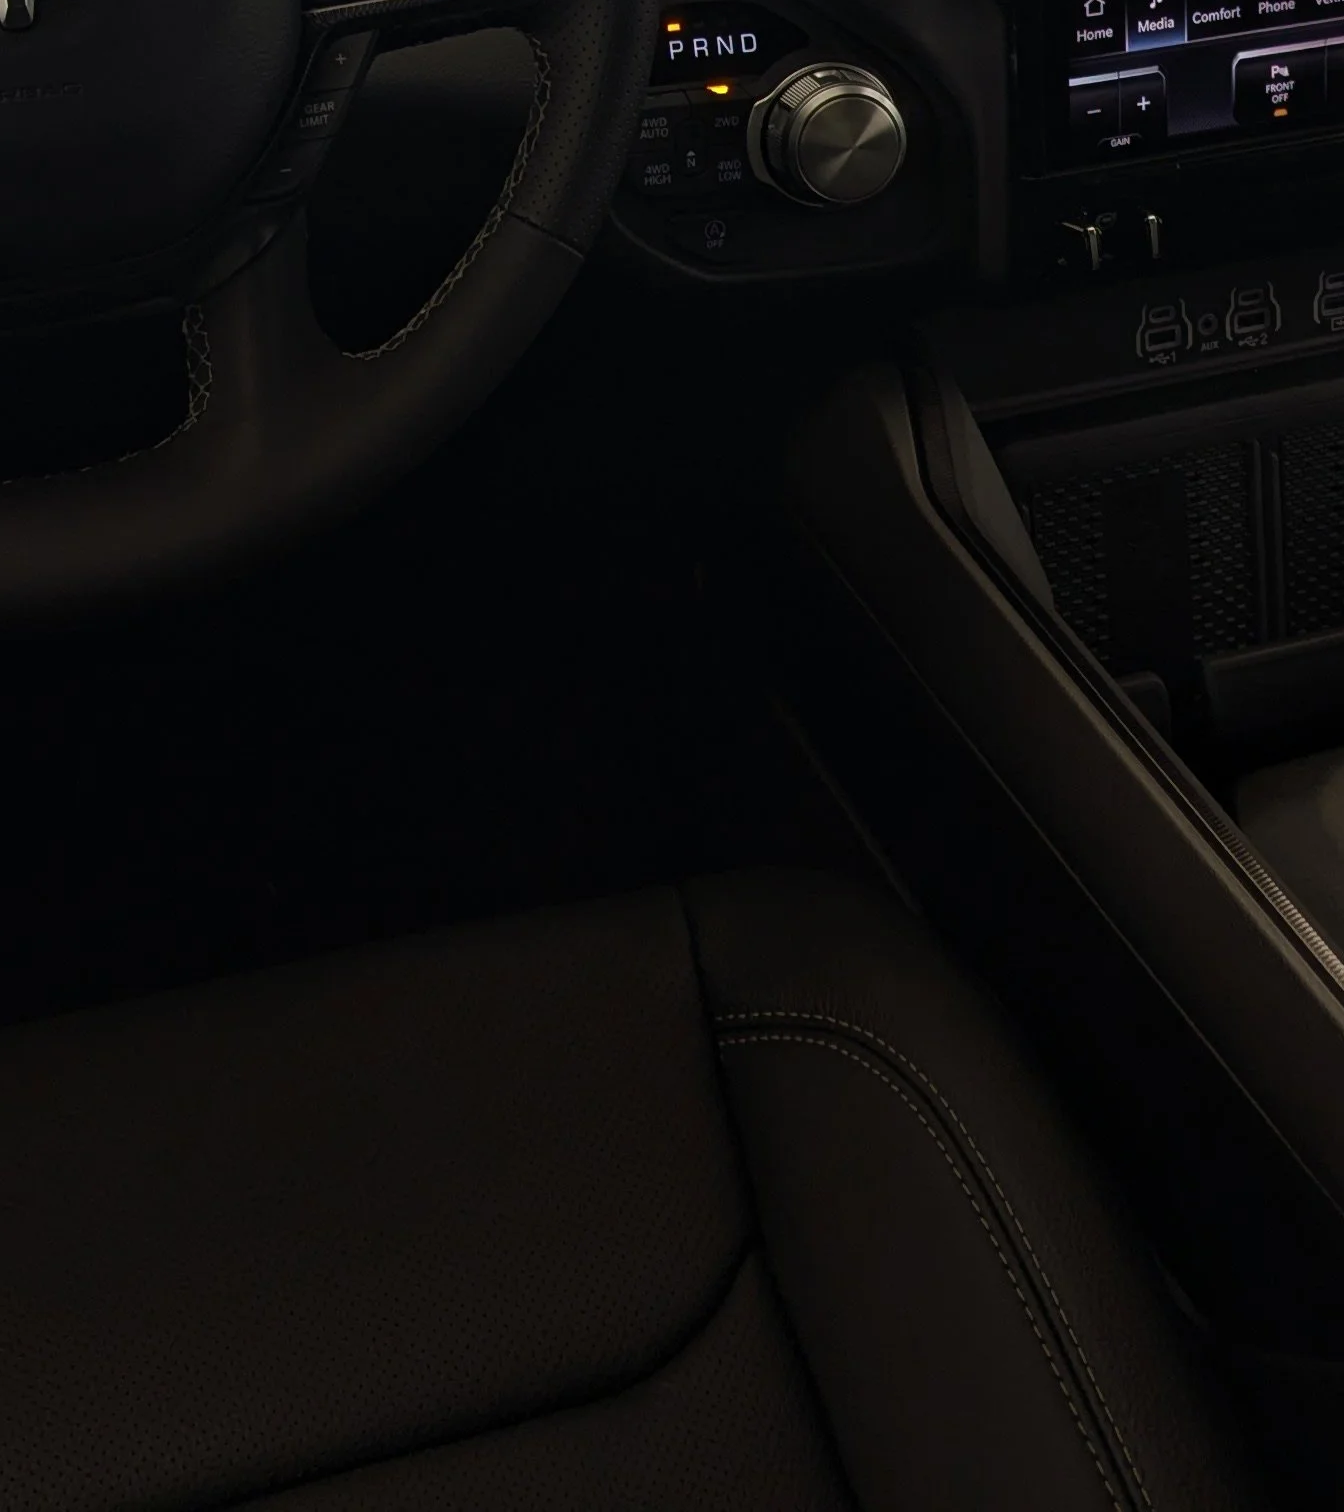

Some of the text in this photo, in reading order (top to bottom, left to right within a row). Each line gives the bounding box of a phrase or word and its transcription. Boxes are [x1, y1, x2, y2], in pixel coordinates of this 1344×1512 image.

[1258, 0, 1296, 15] Phone
[1192, 6, 1242, 25] Comfort
[1137, 17, 1175, 33] Media
[1076, 26, 1114, 43] Home
[1265, 80, 1295, 94] FRONT
[1271, 92, 1289, 105] OFF
[304, 100, 335, 113] GEAR
[299, 115, 329, 128] LIMIT
[641, 117, 667, 129] 4WD
[714, 115, 740, 128] 2WD
[640, 127, 669, 140] AUTO
[1110, 136, 1131, 148] GAIN
[644, 163, 671, 175] 4WD
[685, 157, 696, 169] N
[718, 159, 742, 171] 4WD
[644, 174, 672, 186] HIGH
[718, 170, 742, 183] LOW
[1260, 332, 1268, 345] 2
[1171, 351, 1176, 363] 1
